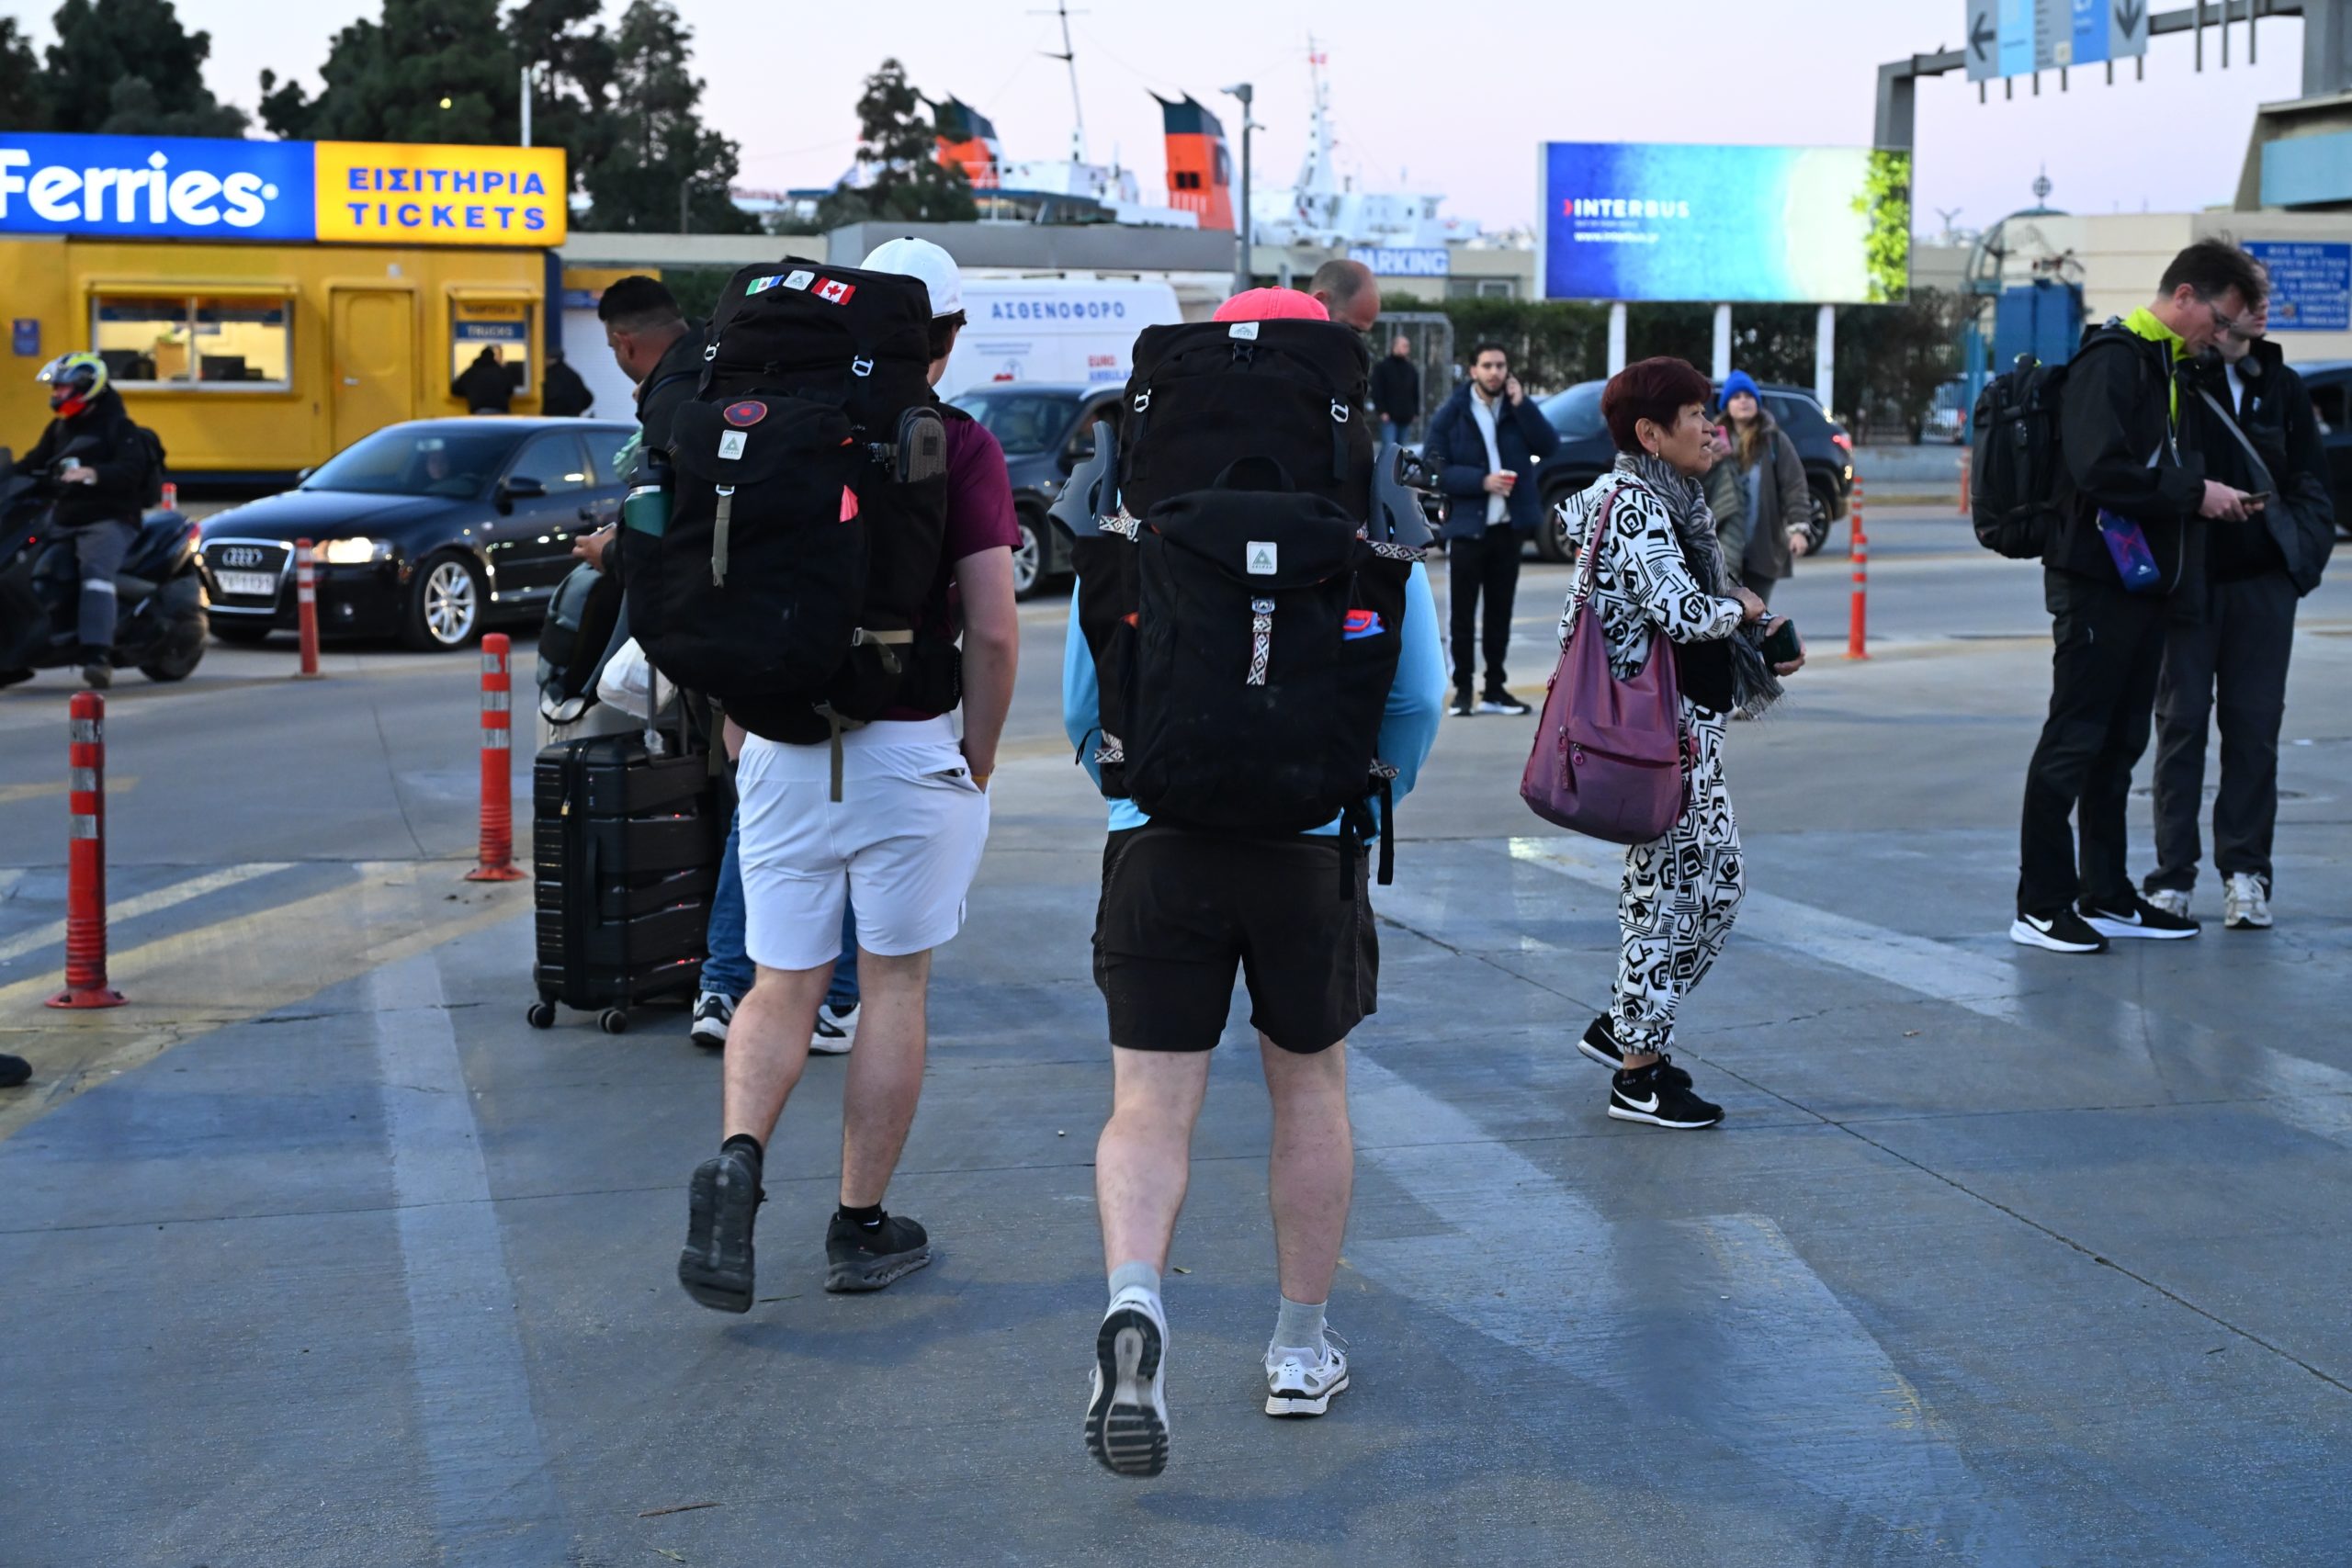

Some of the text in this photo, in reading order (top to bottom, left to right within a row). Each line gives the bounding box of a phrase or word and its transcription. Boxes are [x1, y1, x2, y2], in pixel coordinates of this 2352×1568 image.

[0, 149, 266, 228] Ferries
[348, 167, 546, 195] ΕΙΣΙΤΗΡΙΑ
[347, 202, 545, 230] TICKETS
[1574, 198, 1690, 218] INTERBUS
[991, 301, 1125, 320] ΑΣΘΕΝΟΦΟΡΟ
